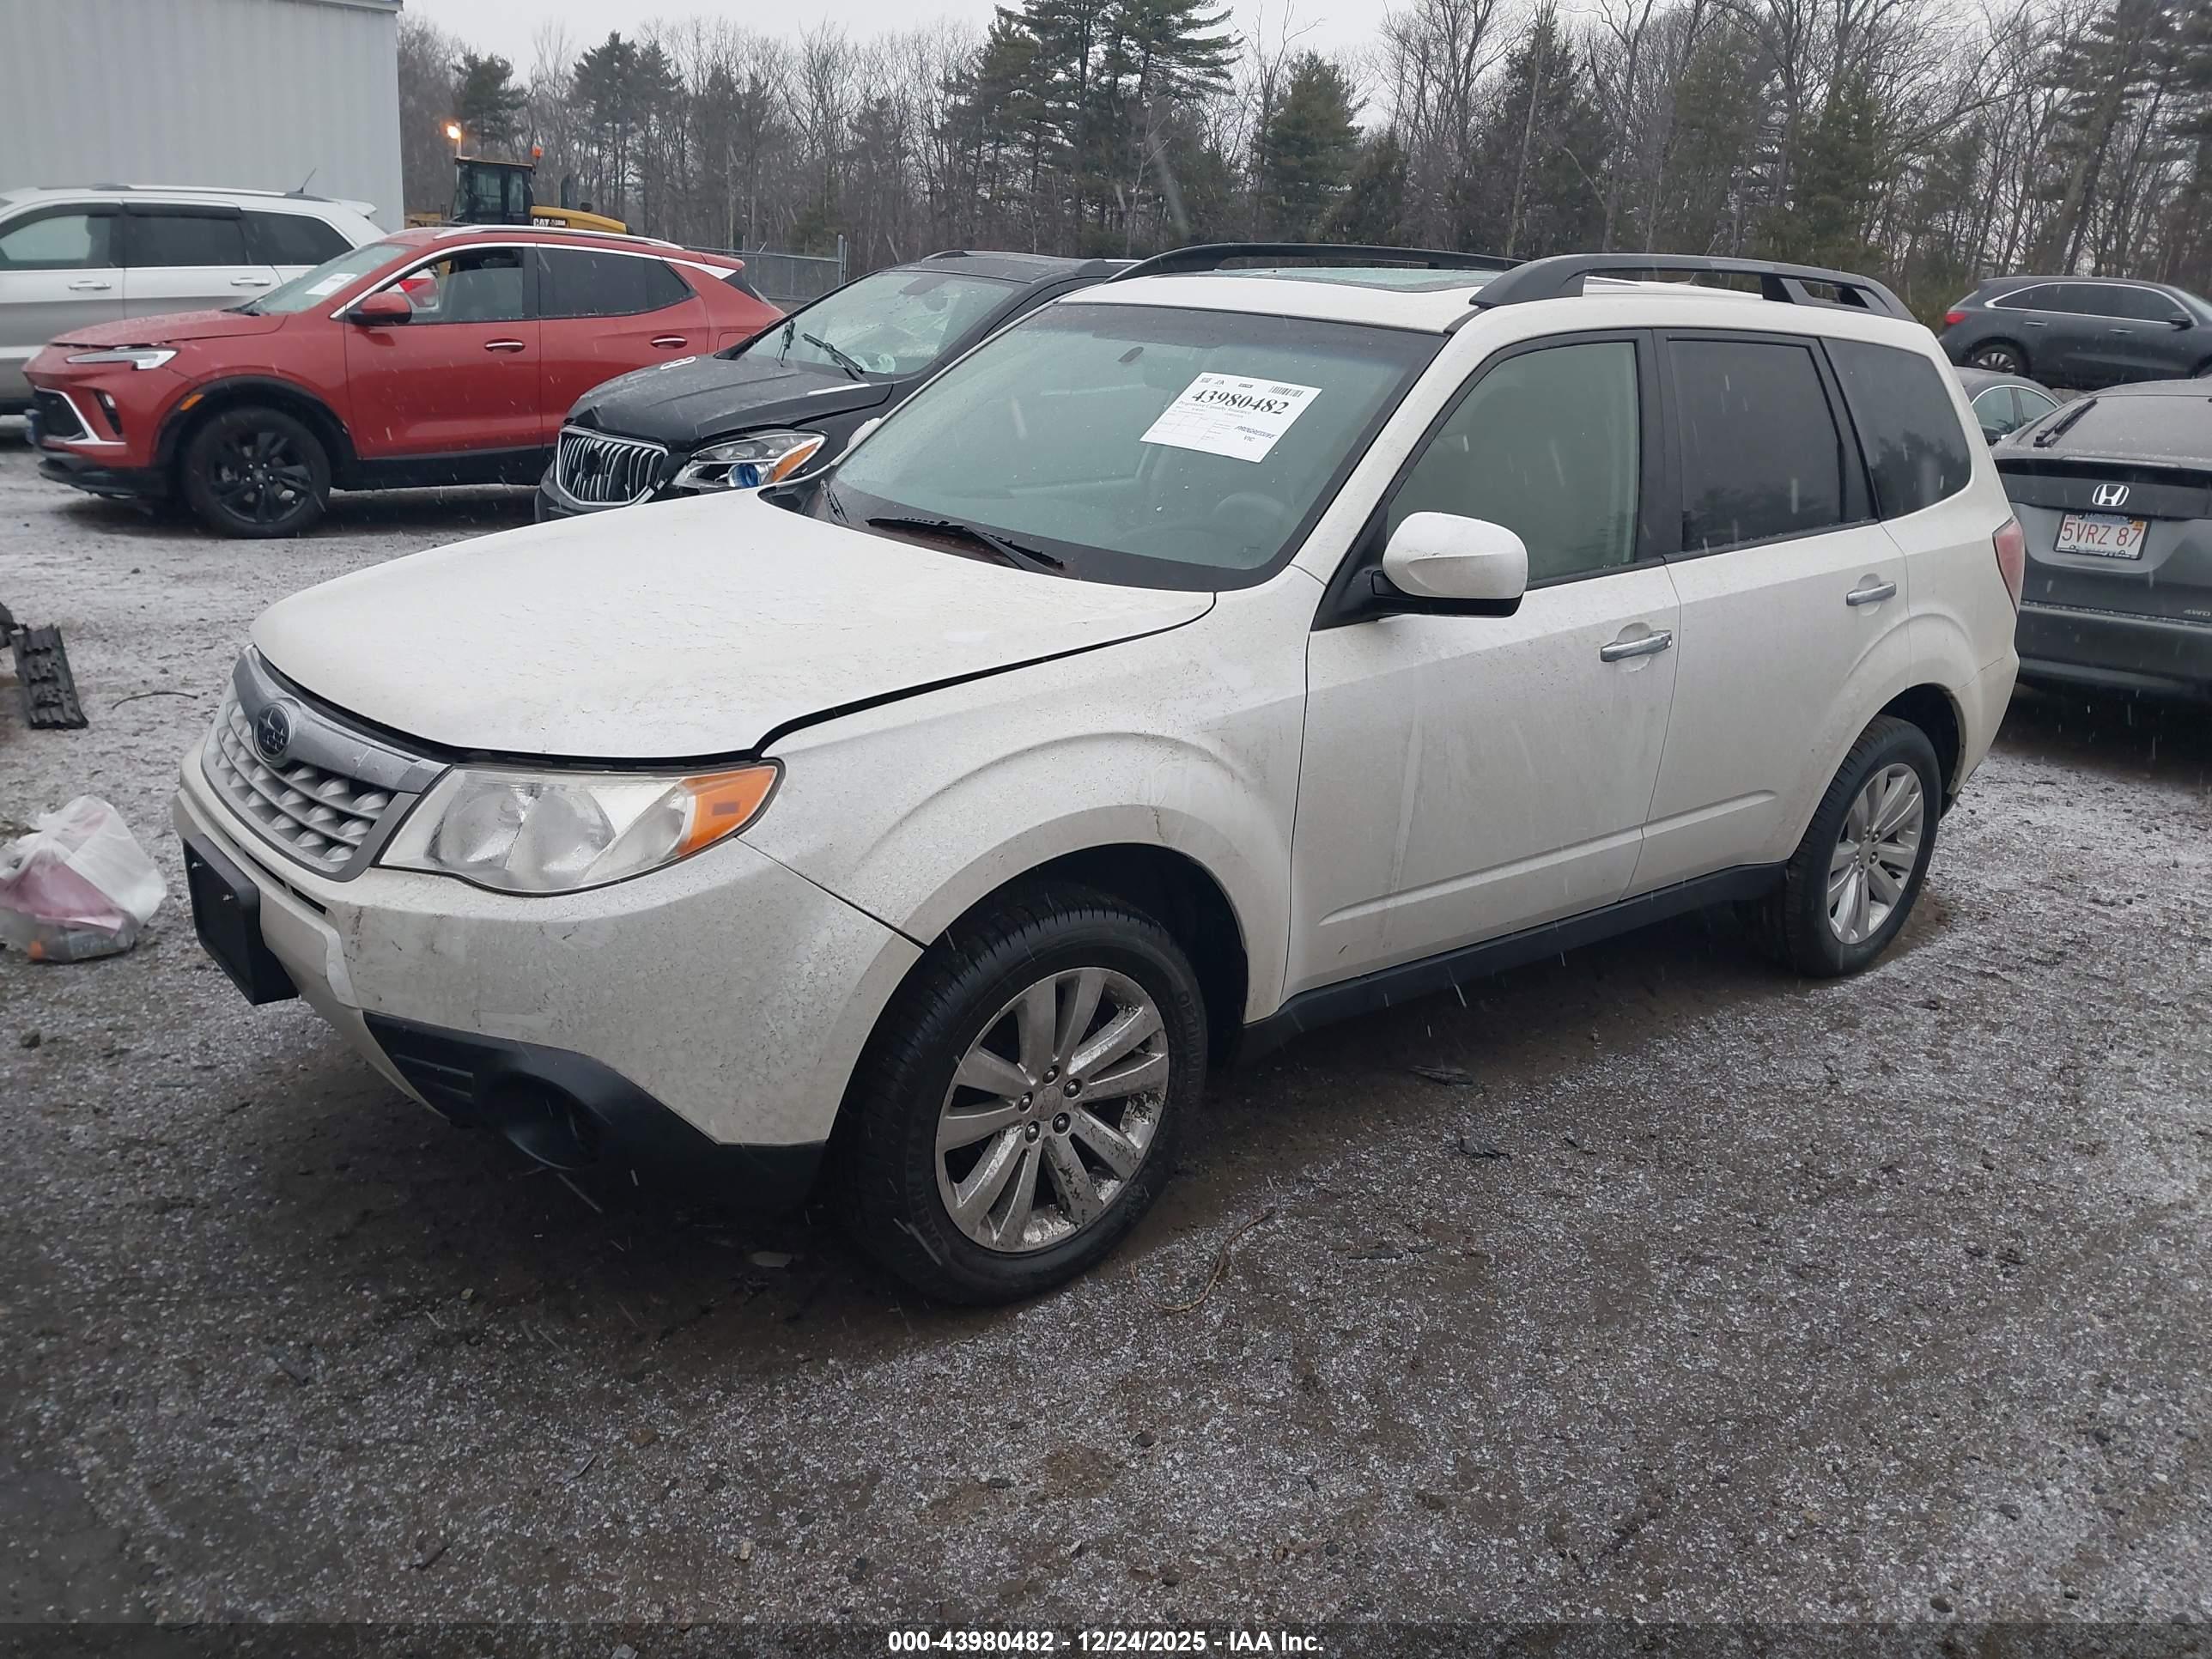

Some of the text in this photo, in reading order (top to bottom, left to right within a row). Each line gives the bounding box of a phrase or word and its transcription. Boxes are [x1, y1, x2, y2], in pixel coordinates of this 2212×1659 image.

[533, 217, 550, 227] CAT
[1191, 389, 1290, 415] 43980482
[2062, 521, 2143, 548] 5VRZ 87
